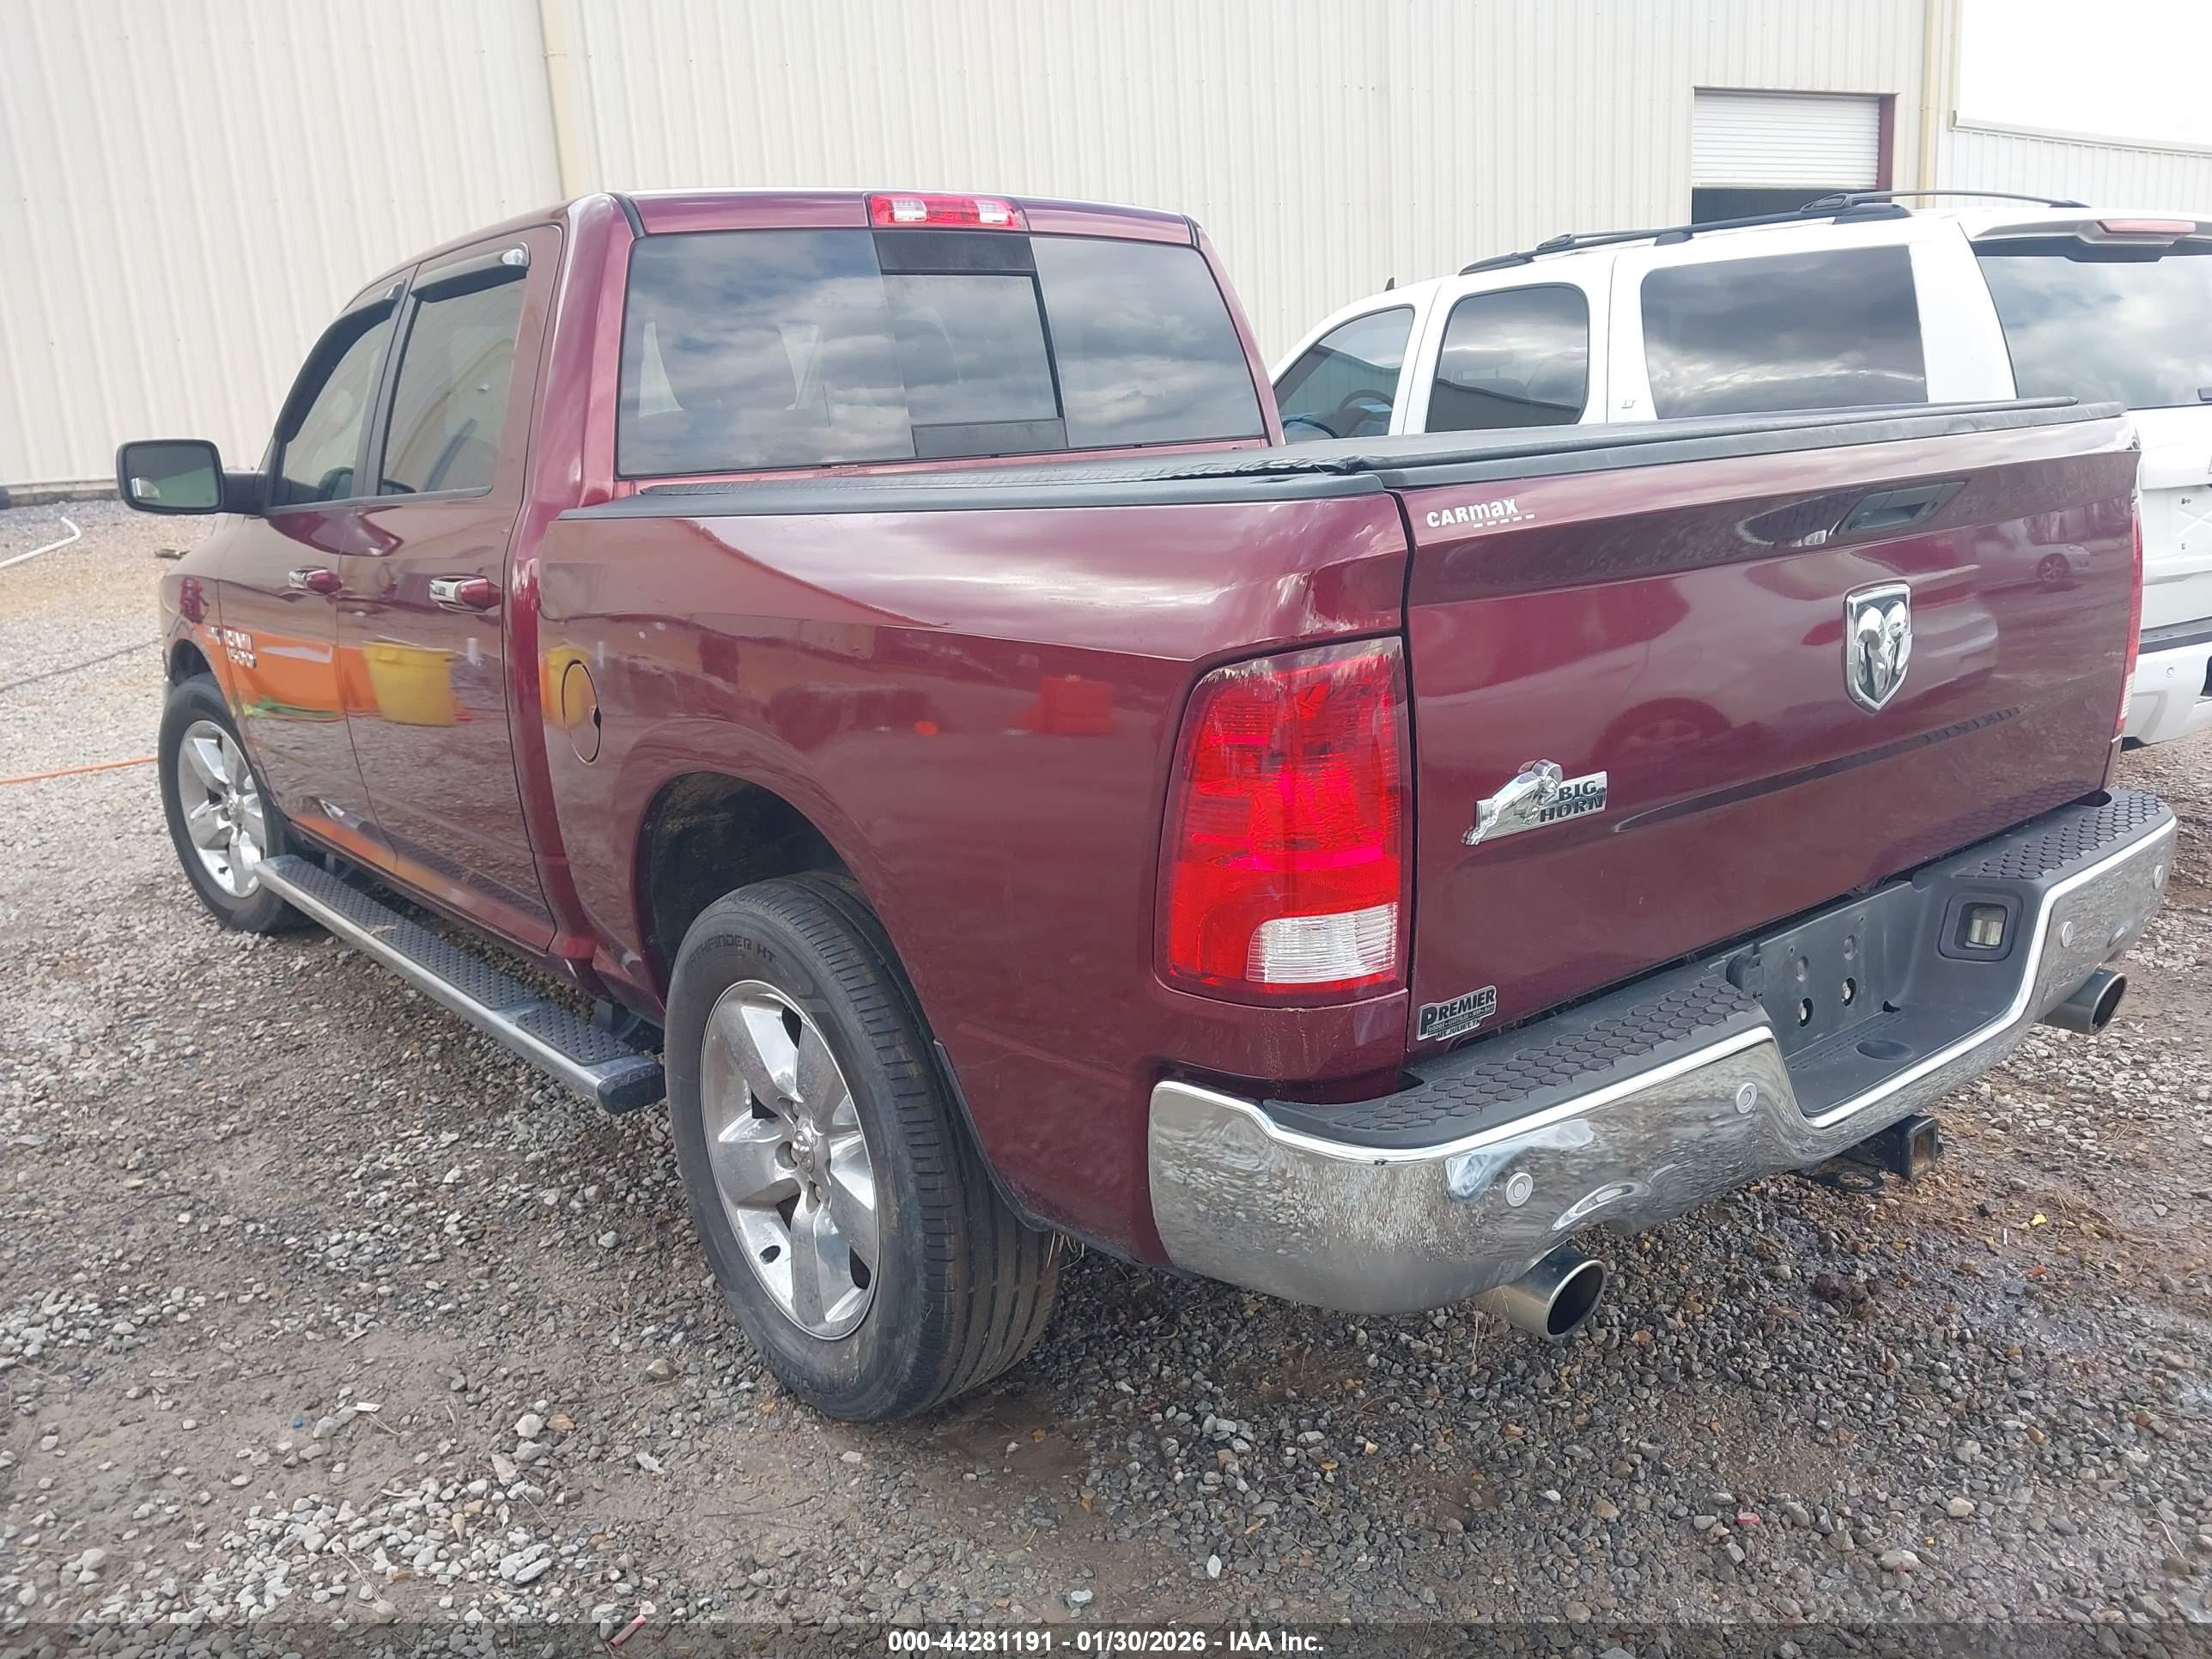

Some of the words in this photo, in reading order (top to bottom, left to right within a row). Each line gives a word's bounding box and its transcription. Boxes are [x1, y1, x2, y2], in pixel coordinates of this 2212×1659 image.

[1559, 780, 1596, 801] BIG
[1540, 795, 1603, 823] HORN
[757, 943, 777, 963] HT
[1419, 988, 1495, 1036] PREMIER
[1472, 1018, 1481, 1026] TN
